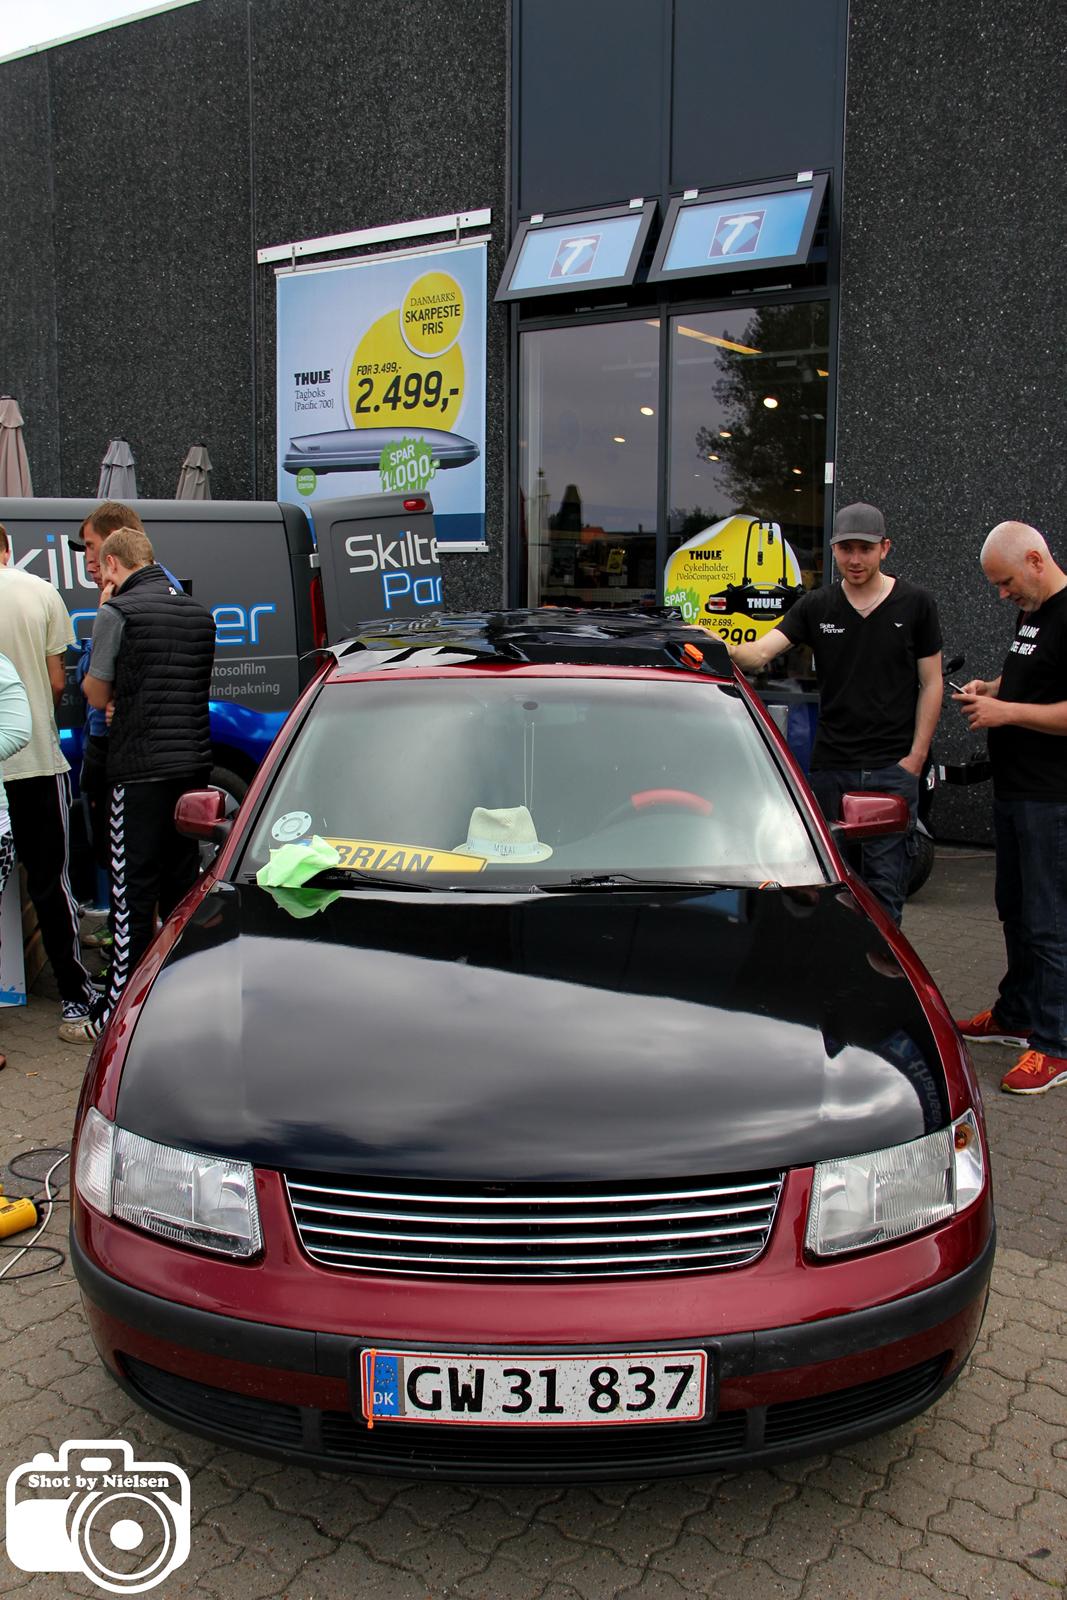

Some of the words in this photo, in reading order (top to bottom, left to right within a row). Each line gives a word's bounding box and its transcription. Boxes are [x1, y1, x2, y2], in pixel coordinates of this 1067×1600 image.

[410, 292, 456, 306] DANMARKS
[405, 304, 461, 323] SKARPESTE
[422, 321, 444, 336] PRIS
[373, 361, 402, 374] 3.499,-
[294, 370, 331, 386] THULE
[295, 388, 326, 401] Tagboks
[355, 370, 459, 413] 2.499,-
[390, 445, 415, 466] SPAR
[689, 550, 722, 560] THULE
[683, 563, 729, 574] Cykelholder
[665, 591, 687, 607] SPAR
[747, 598, 782, 609] THULE
[406, 1365, 485, 1413] GW
[501, 1367, 564, 1414] 31
[588, 1364, 695, 1414] 837
[373, 1391, 395, 1406] DK
